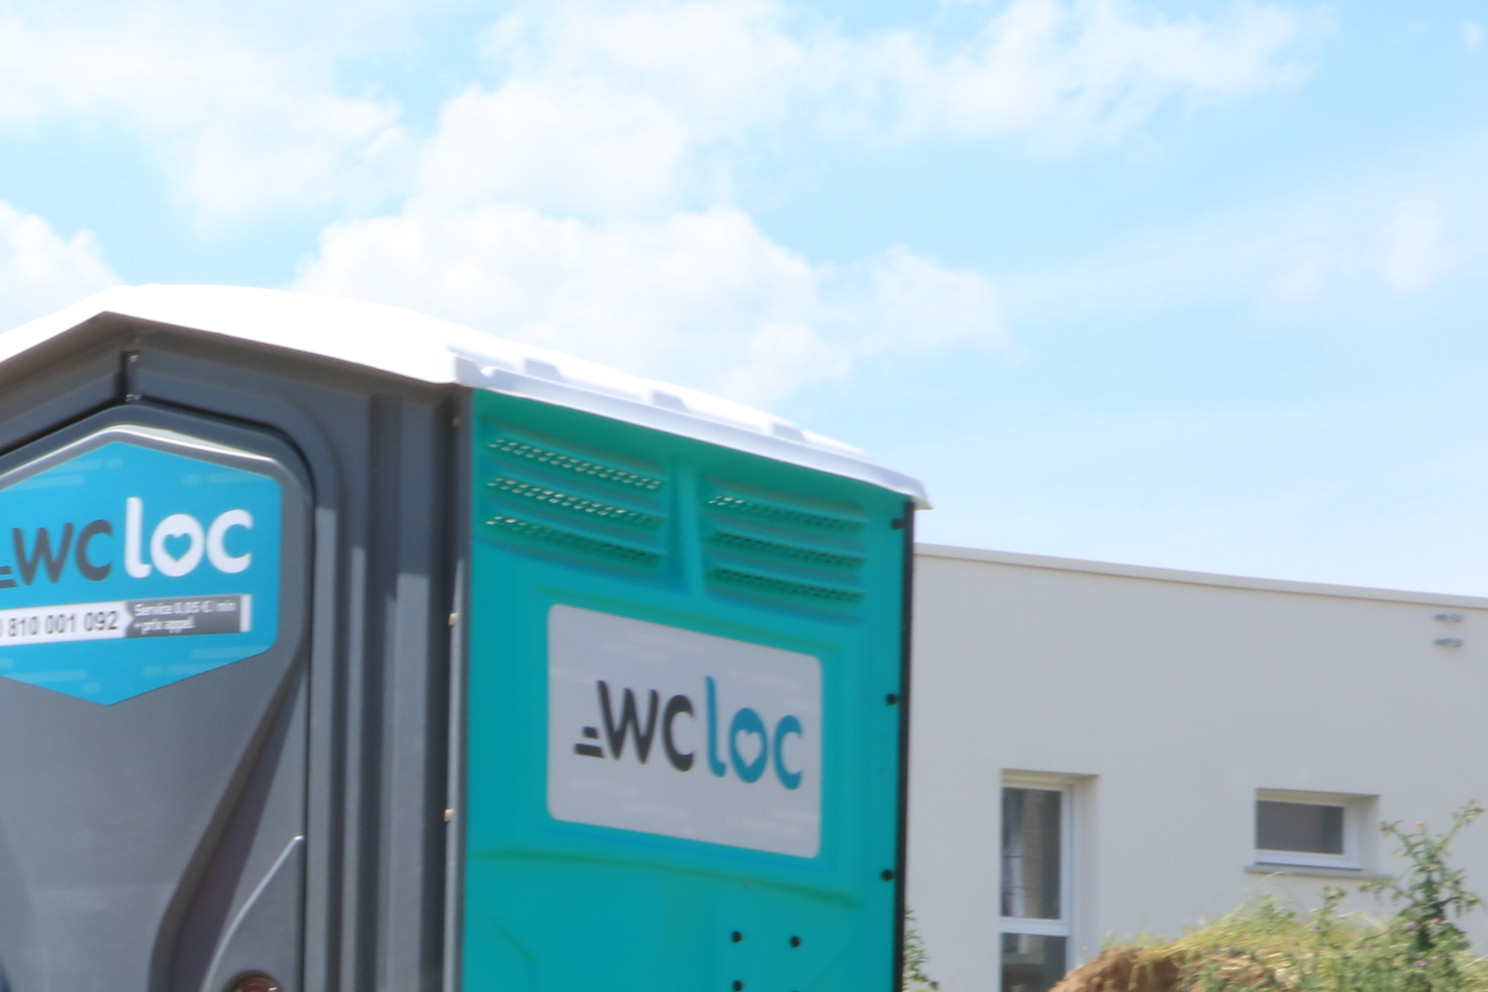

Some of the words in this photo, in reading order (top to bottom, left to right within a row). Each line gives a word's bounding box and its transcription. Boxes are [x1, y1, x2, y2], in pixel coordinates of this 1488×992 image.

[8, 616, 40, 638] 810
[45, 613, 77, 635] 001
[83, 610, 119, 632] 092
